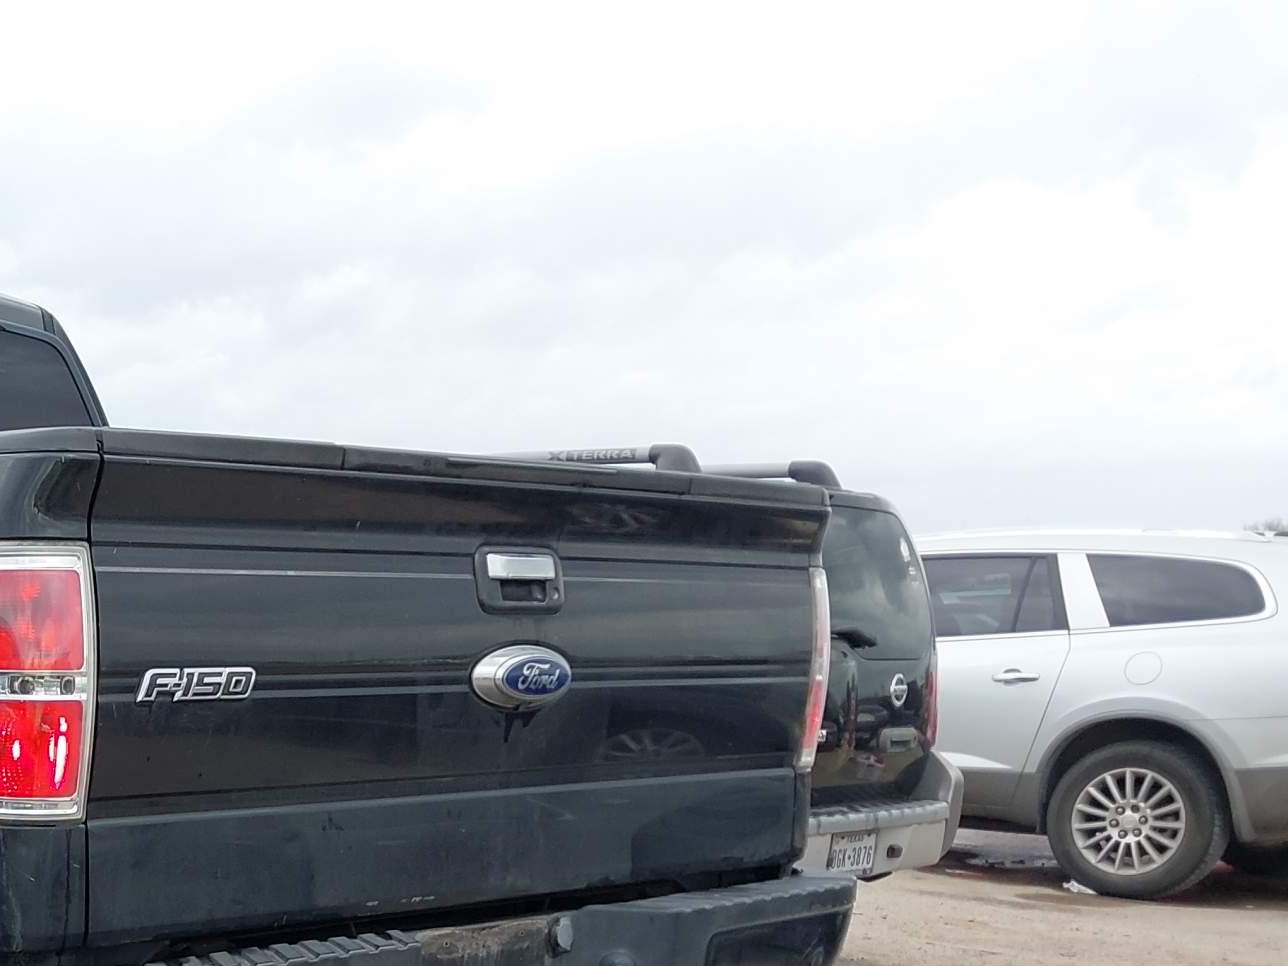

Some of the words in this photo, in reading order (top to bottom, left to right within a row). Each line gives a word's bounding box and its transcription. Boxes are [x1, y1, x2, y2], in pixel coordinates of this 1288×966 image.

[547, 449, 635, 462] XTERRA
[136, 667, 256, 702] F-150
[518, 662, 560, 690] Ford
